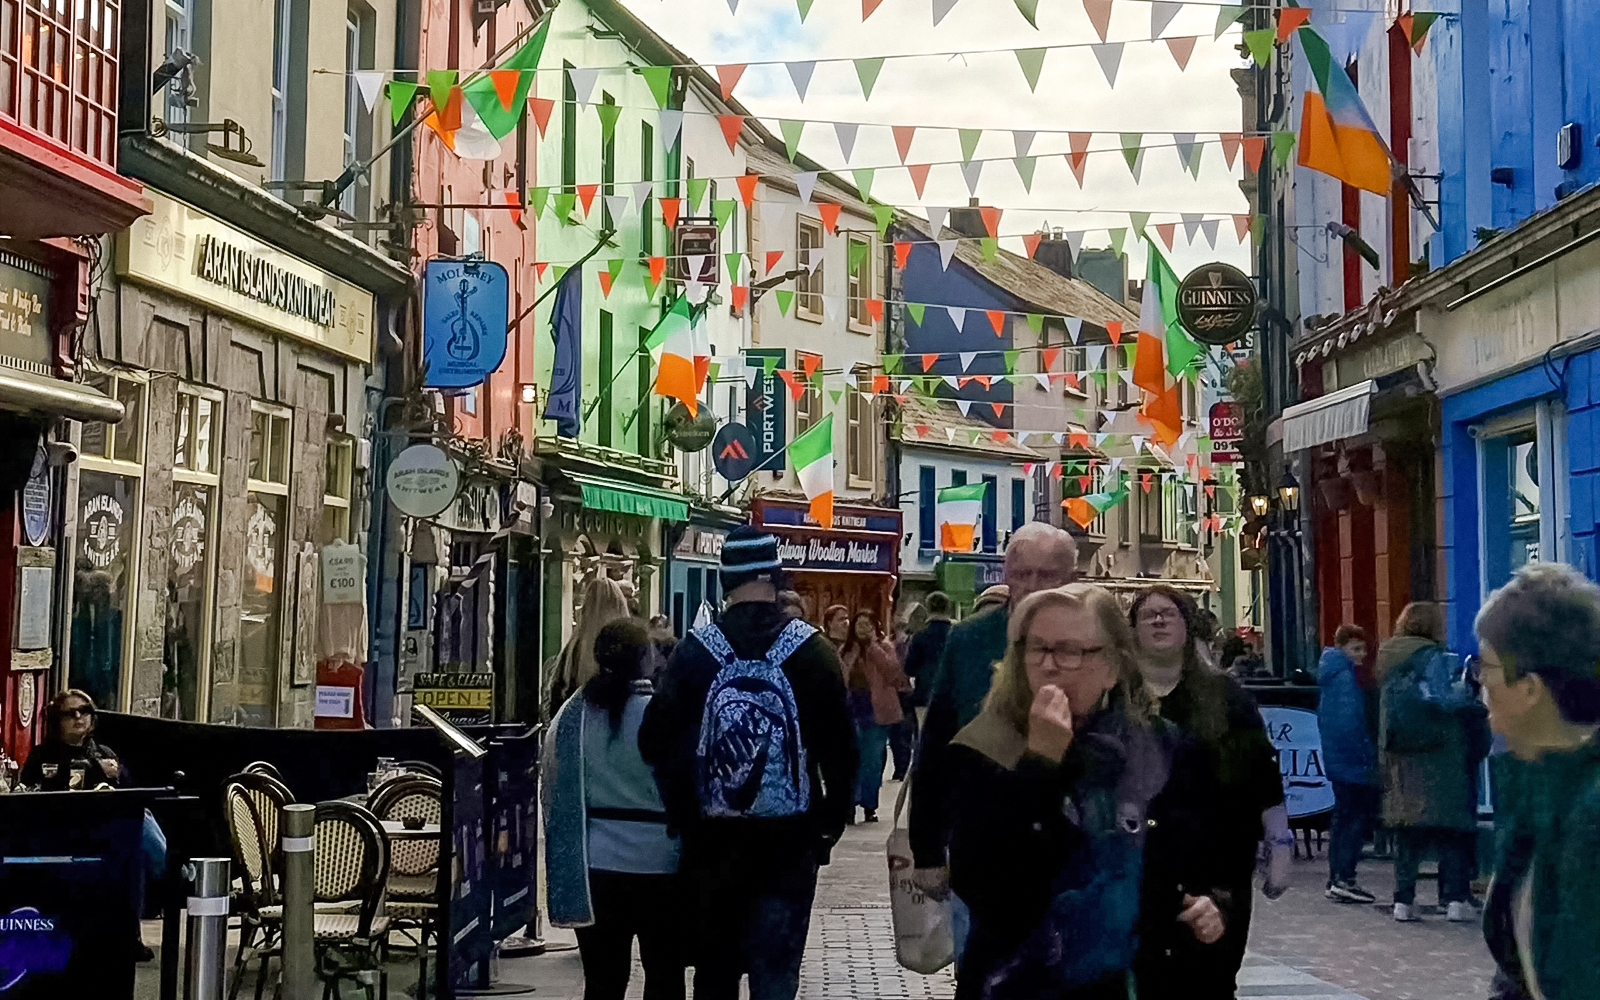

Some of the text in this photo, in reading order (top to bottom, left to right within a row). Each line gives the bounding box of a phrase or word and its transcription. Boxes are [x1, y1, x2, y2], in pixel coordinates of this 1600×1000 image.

[203, 234, 336, 329] ARAN ISLANDS KNITWEAR
[1181, 290, 1251, 306] GUINNESS
[763, 372, 775, 453] PORTWES
[775, 536, 879, 566] Galway Woollen Market
[330, 577, 355, 589] €100
[419, 673, 448, 686] SAFE
[458, 673, 492, 687] CLEAN
[1266, 721, 1293, 742] AR
[1277, 748, 1326, 776] LIA
[0, 918, 54, 931] UINNESS
